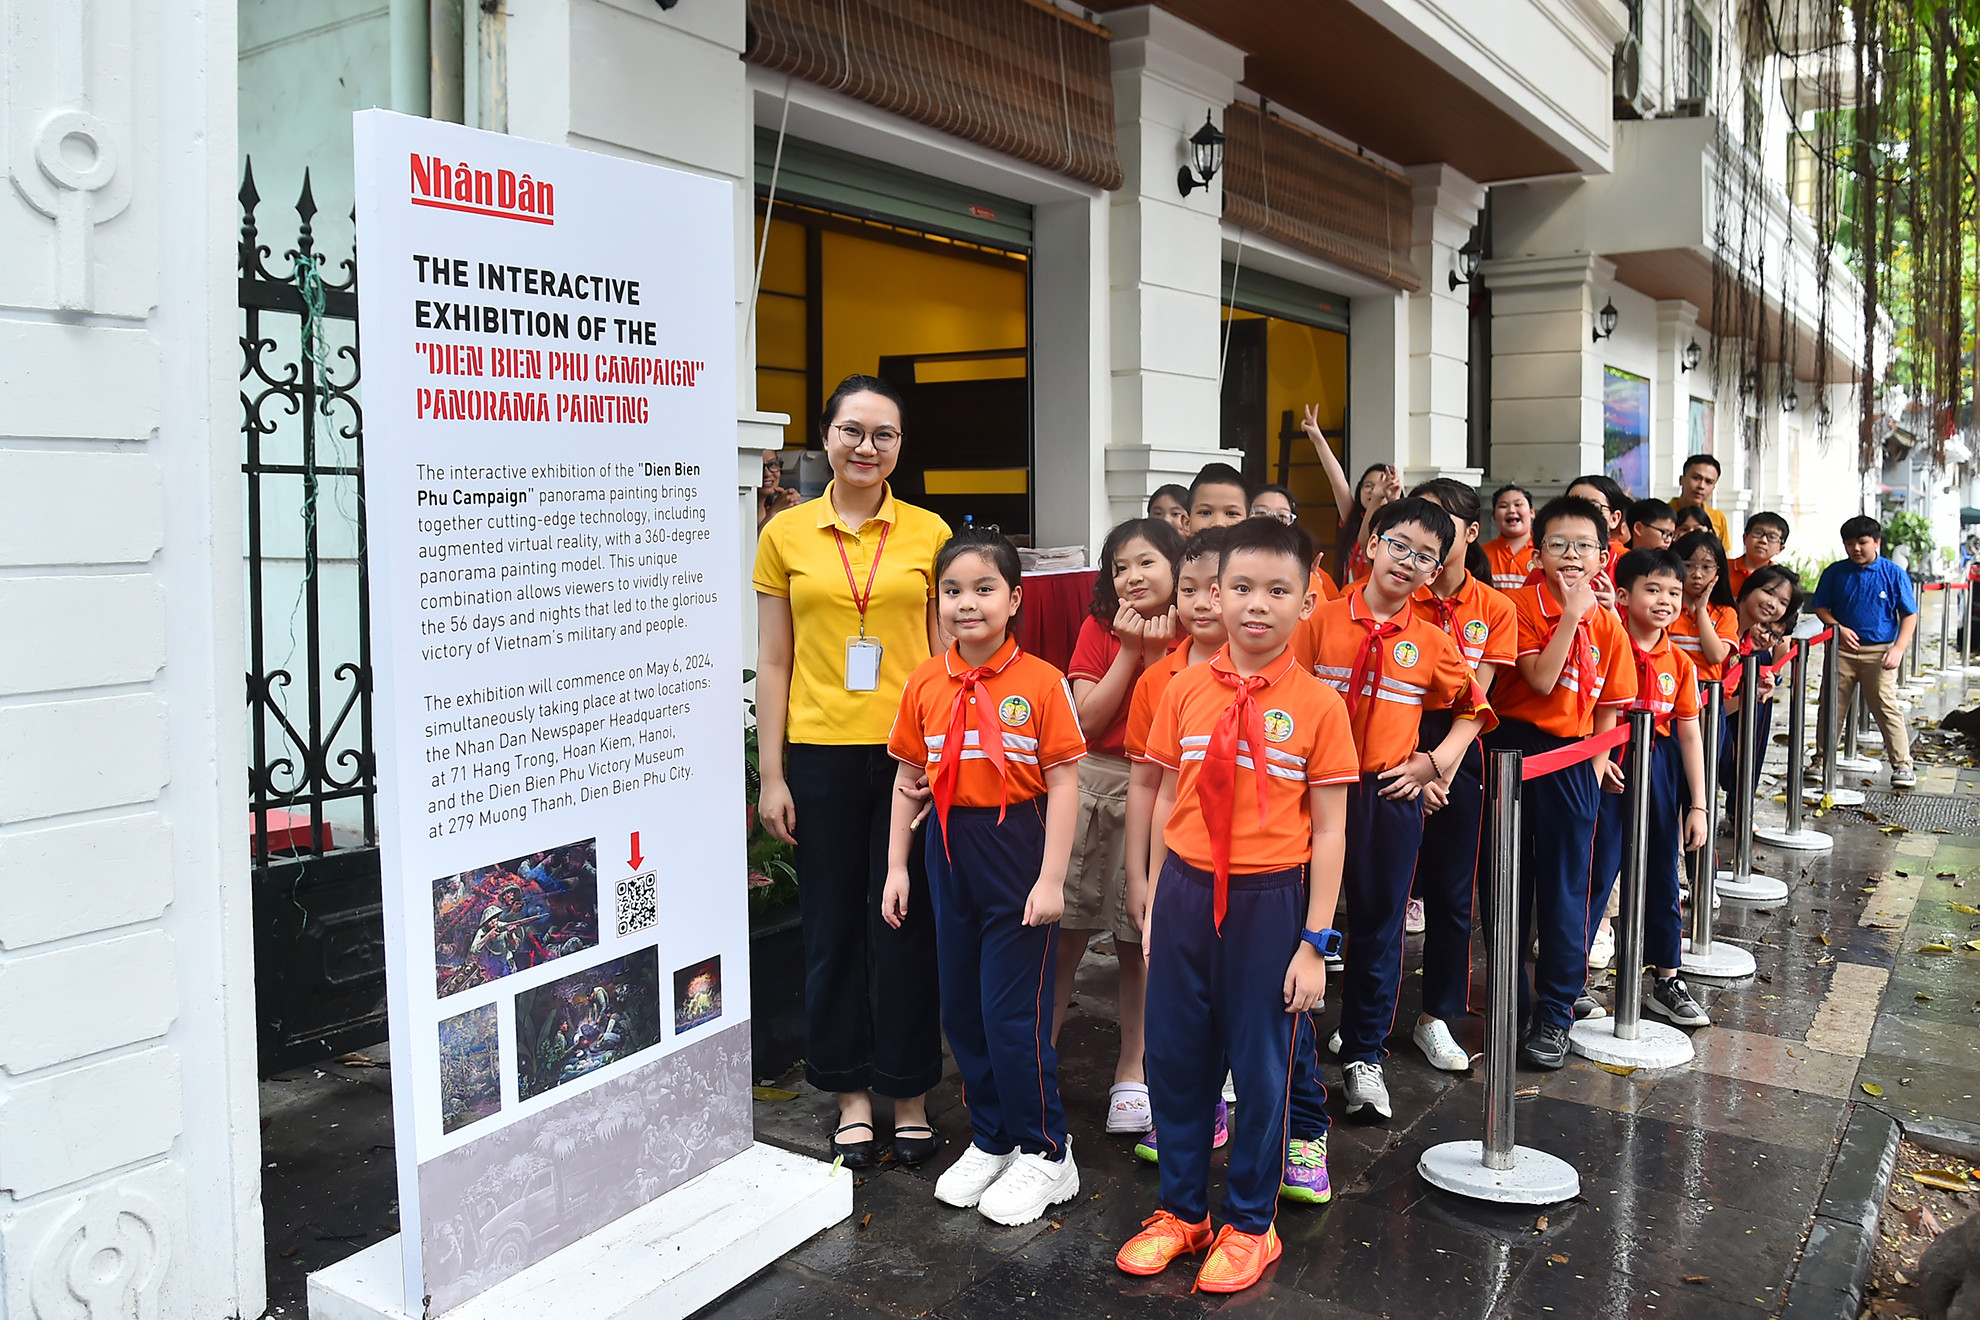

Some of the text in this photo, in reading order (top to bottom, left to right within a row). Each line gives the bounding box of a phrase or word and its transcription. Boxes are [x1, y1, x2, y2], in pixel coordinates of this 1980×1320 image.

[410, 153, 554, 216] Nhân Dân
[413, 254, 640, 306] THE INTERACTIVE
[415, 300, 657, 346] EXHIBITION OF THE
[415, 342, 704, 387] "DIEN BIEN PHU CAMPAIGN"
[417, 388, 649, 424] PANORAMA PAINTING
[416, 462, 700, 480] The interactive exhibition of the "Dien Bien
[418, 484, 697, 508] Phu Campaign" panorama painting brings
[418, 505, 705, 536] together cutting-edge technology, including
[419, 528, 710, 562] augmented virtual reality, with a 360-degree
[420, 552, 677, 589] panorama painting model. This unique
[421, 570, 703, 610] combination allows viewers to vividly relive
[421, 592, 717, 636] the 56 days and nights that led to the glorious
[421, 644, 472, 661] victory
[477, 637, 490, 654] of
[568, 626, 617, 642] military
[620, 619, 642, 636] and
[646, 615, 687, 636] people.
[423, 653, 713, 712] The exhibition will commence on May 6, 2024,
[425, 678, 711, 738] simultaneously taking place at two locations:
[426, 703, 690, 763] the Nhan Dan Newspaper Headquarters
[431, 725, 675, 788] at 71 Hang Trong, Hoan Kiem, Hanoi,
[428, 747, 684, 814] and the Dien Bien Phu Victory Museum
[429, 766, 693, 839] at 279 Muong Thanh, Dien Bien Phu City.
